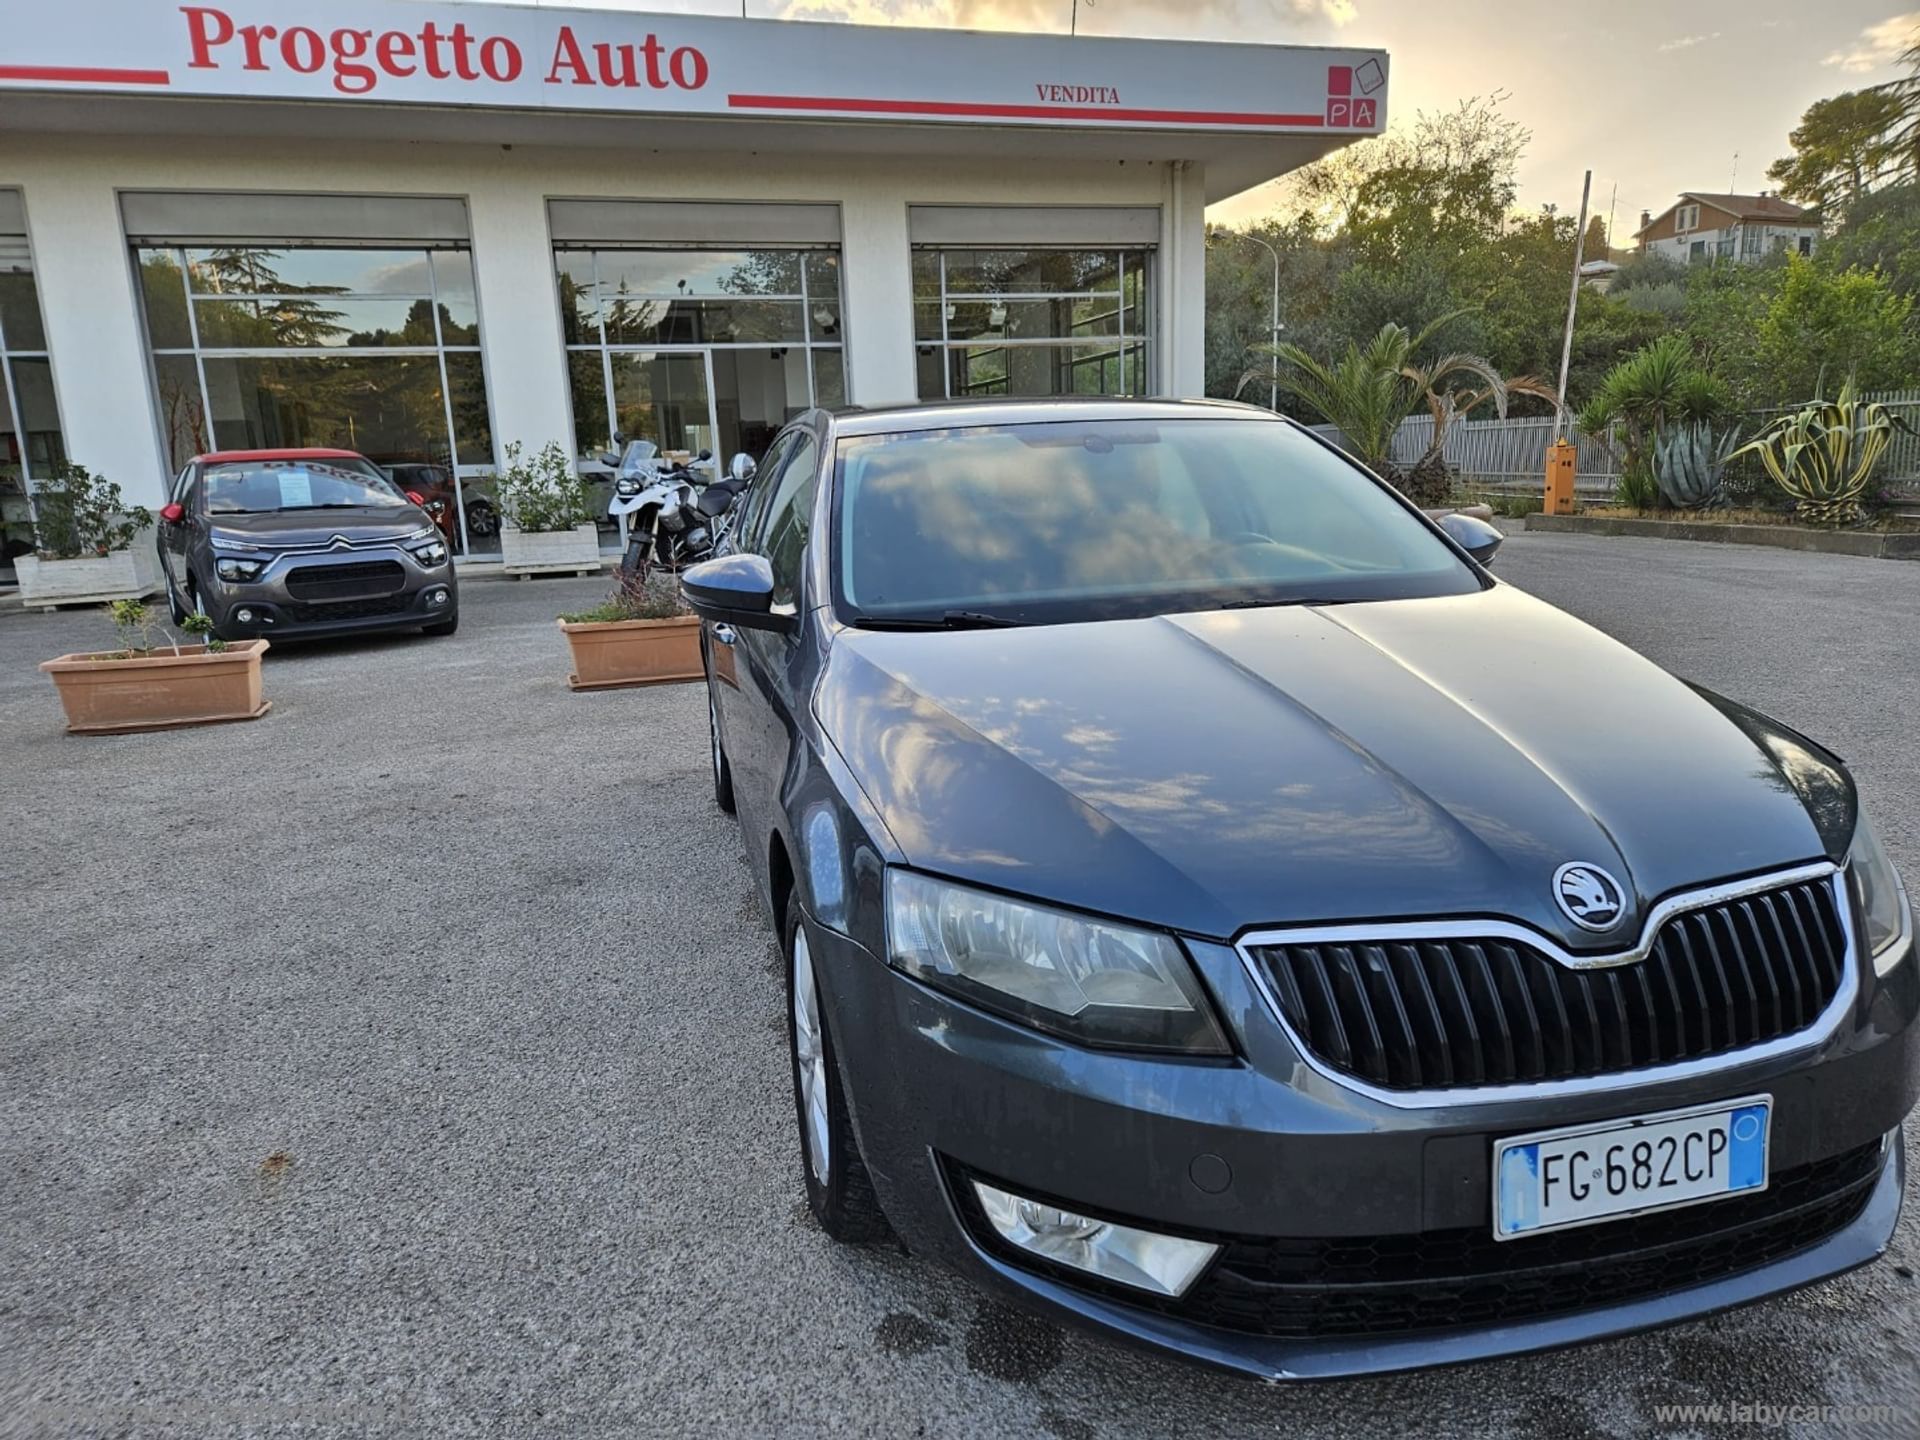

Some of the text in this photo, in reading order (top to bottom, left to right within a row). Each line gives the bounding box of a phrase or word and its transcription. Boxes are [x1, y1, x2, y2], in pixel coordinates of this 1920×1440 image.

[179, 6, 709, 94] Progetto Auto
[1036, 84, 1121, 104] VENDITA
